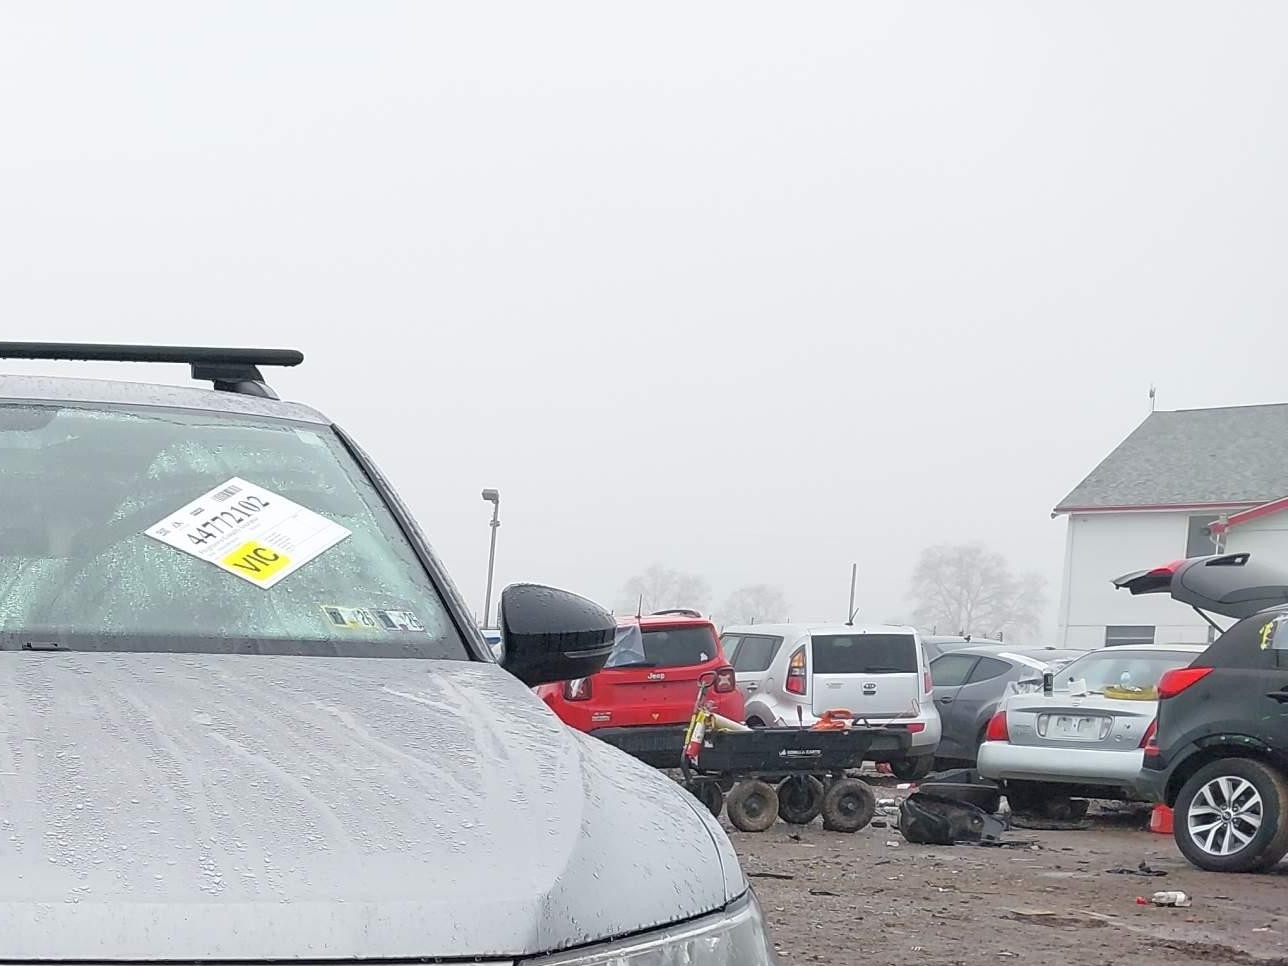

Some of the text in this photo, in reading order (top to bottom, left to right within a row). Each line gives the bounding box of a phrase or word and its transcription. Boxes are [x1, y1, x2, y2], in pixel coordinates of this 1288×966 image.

[187, 495, 270, 545] 44772102
[233, 547, 279, 573] VIC
[648, 672, 665, 680] Jeep
